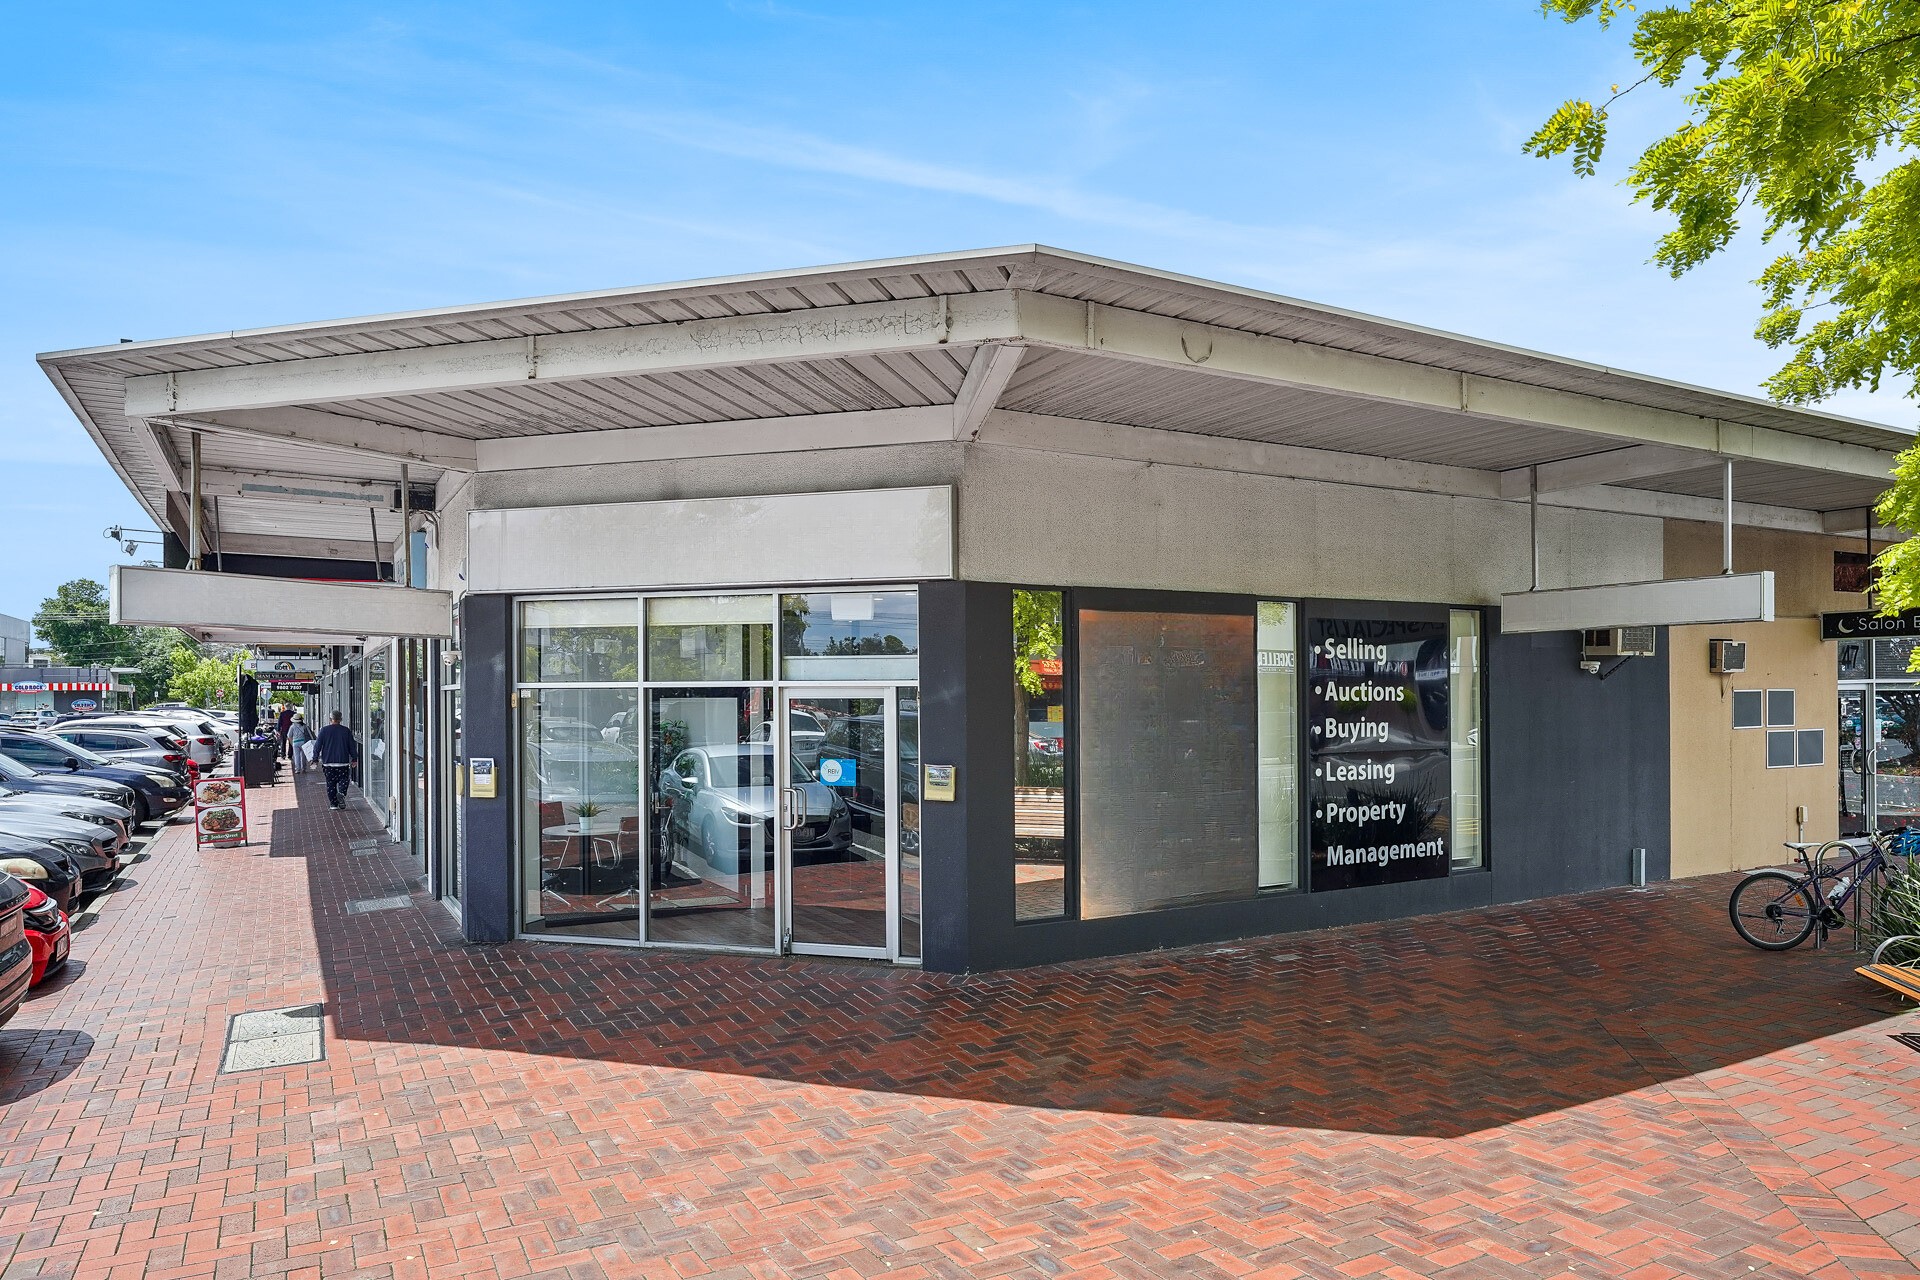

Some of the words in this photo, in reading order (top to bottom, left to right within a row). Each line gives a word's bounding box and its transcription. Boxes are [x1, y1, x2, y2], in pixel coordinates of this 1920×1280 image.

[1858, 617, 1905, 631] Salon
[1324, 637, 1387, 666] Selling
[1324, 680, 1405, 702] Auctions
[1325, 716, 1389, 744] Buying
[1326, 758, 1395, 785] Leasing
[1326, 800, 1407, 827] Property
[1326, 837, 1444, 867] Management
